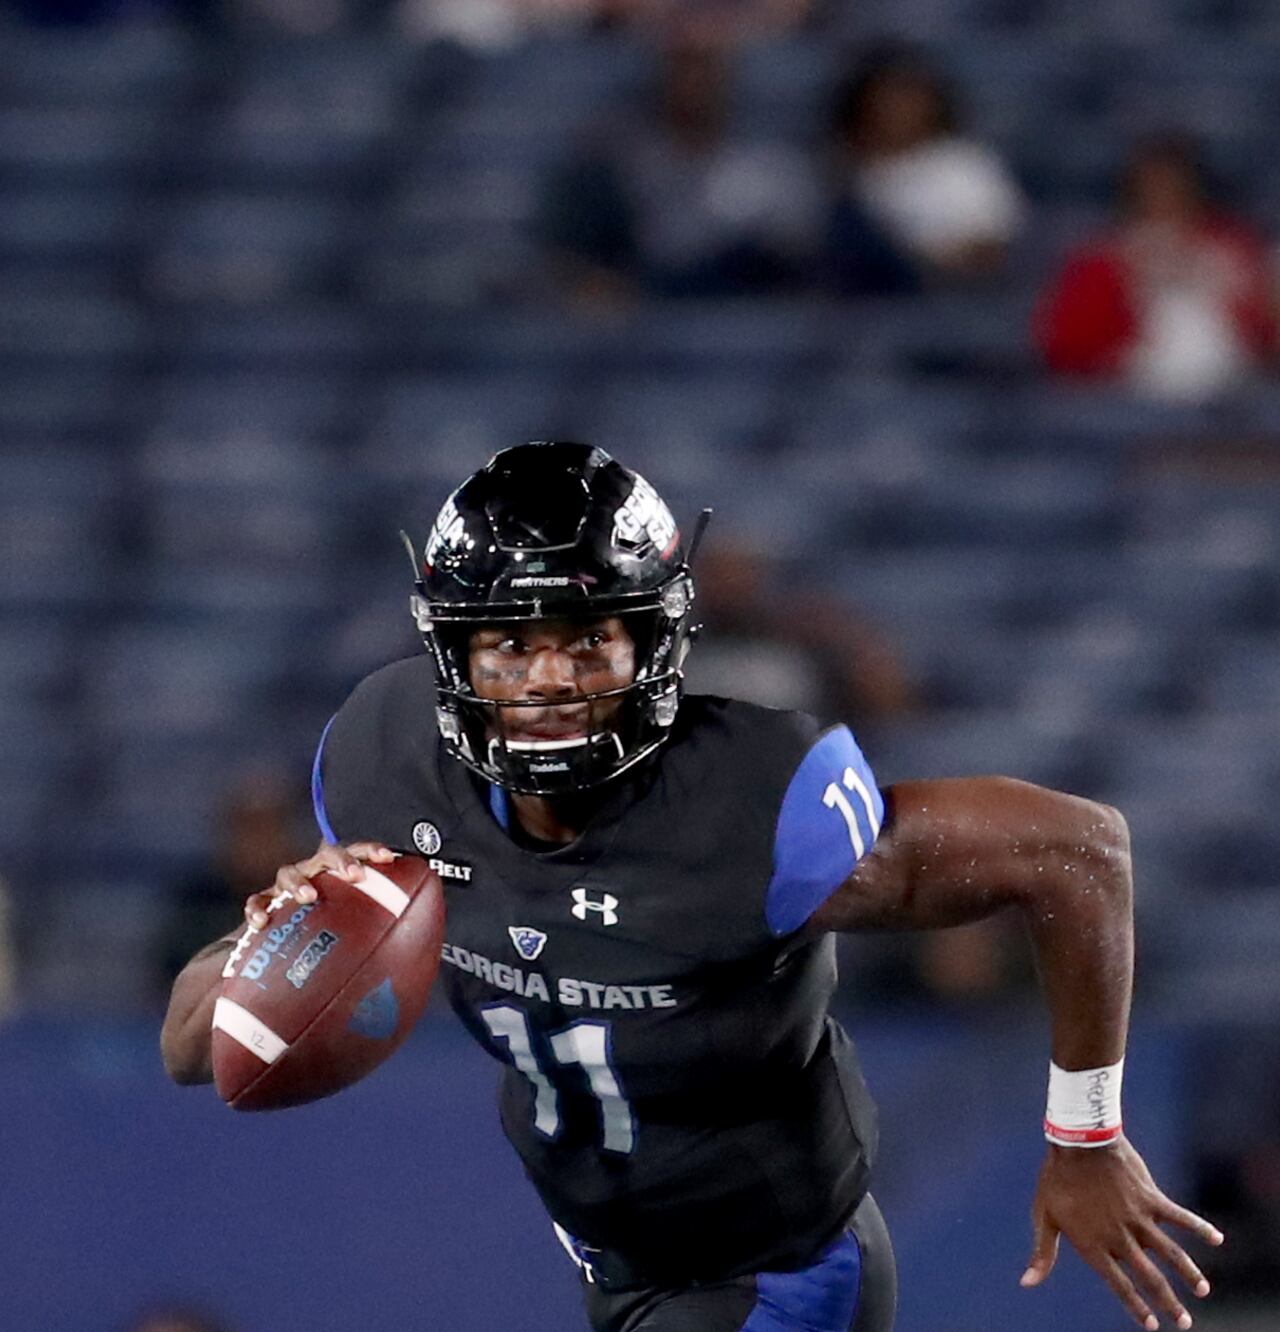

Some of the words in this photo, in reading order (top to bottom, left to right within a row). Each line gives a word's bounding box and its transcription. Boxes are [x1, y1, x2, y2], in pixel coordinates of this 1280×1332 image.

[822, 766, 880, 861] 11
[286, 929, 339, 989] NCAA
[440, 943, 551, 1003] EORGIA
[558, 978, 677, 1009] STATE
[478, 1001, 636, 1155] 11
